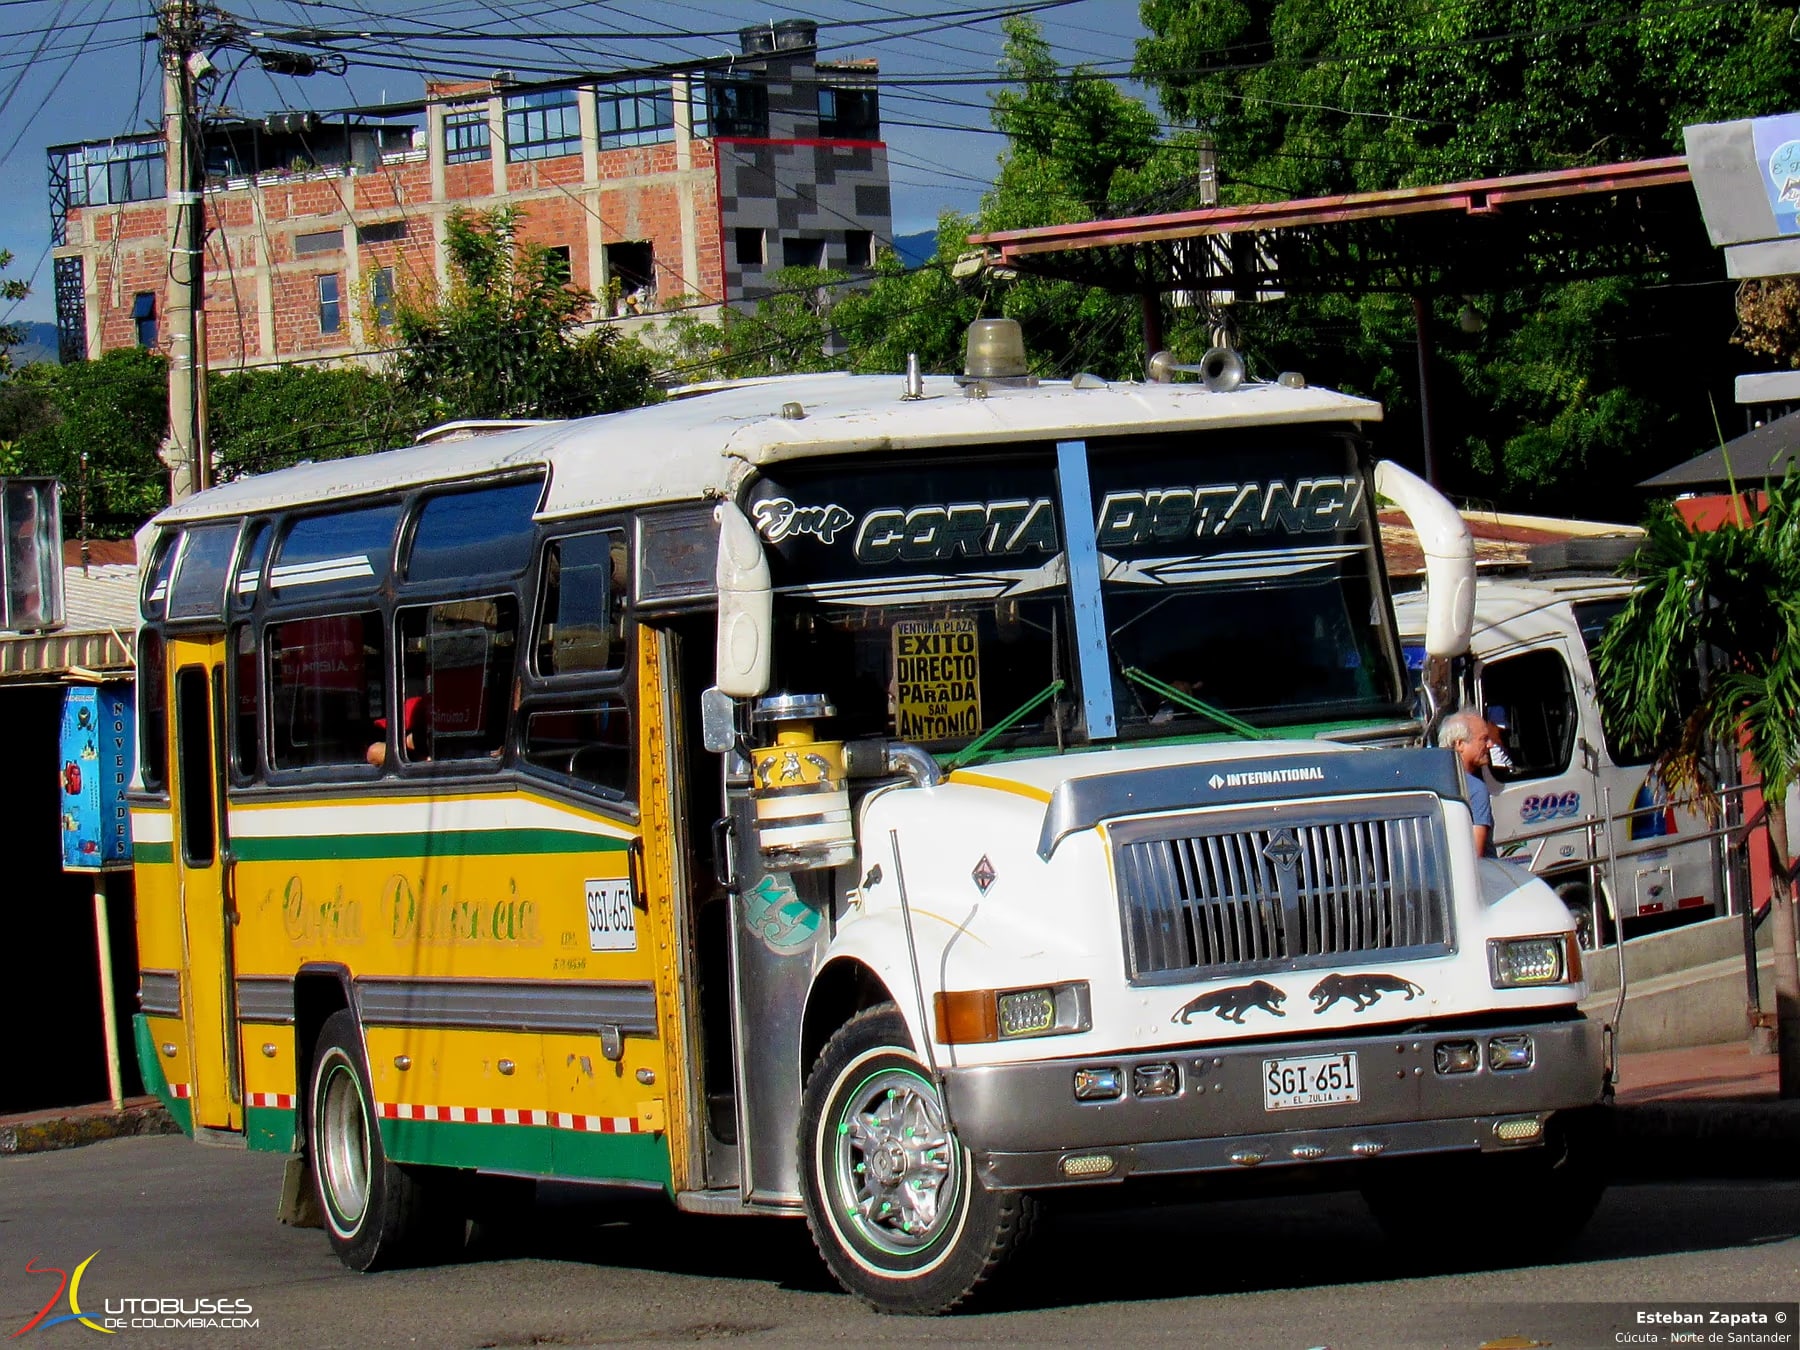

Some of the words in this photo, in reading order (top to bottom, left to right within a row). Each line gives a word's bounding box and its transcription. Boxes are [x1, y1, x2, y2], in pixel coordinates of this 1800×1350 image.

[752, 498, 854, 543] Emp
[853, 497, 1059, 564] CORTA
[898, 623, 940, 634] VENTURA
[944, 620, 975, 632] PLAZA
[898, 633, 975, 655] EXITO
[897, 655, 977, 683] DIRECTO
[898, 681, 977, 704] PARADA
[928, 703, 948, 715] SAN
[900, 705, 978, 740] ANTONIO
[1226, 766, 1325, 788] INTERNATIONAL
[1520, 789, 1580, 824] 306
[1293, 1095, 1303, 1105] EL
[1308, 1093, 1333, 1104] ZULIA
